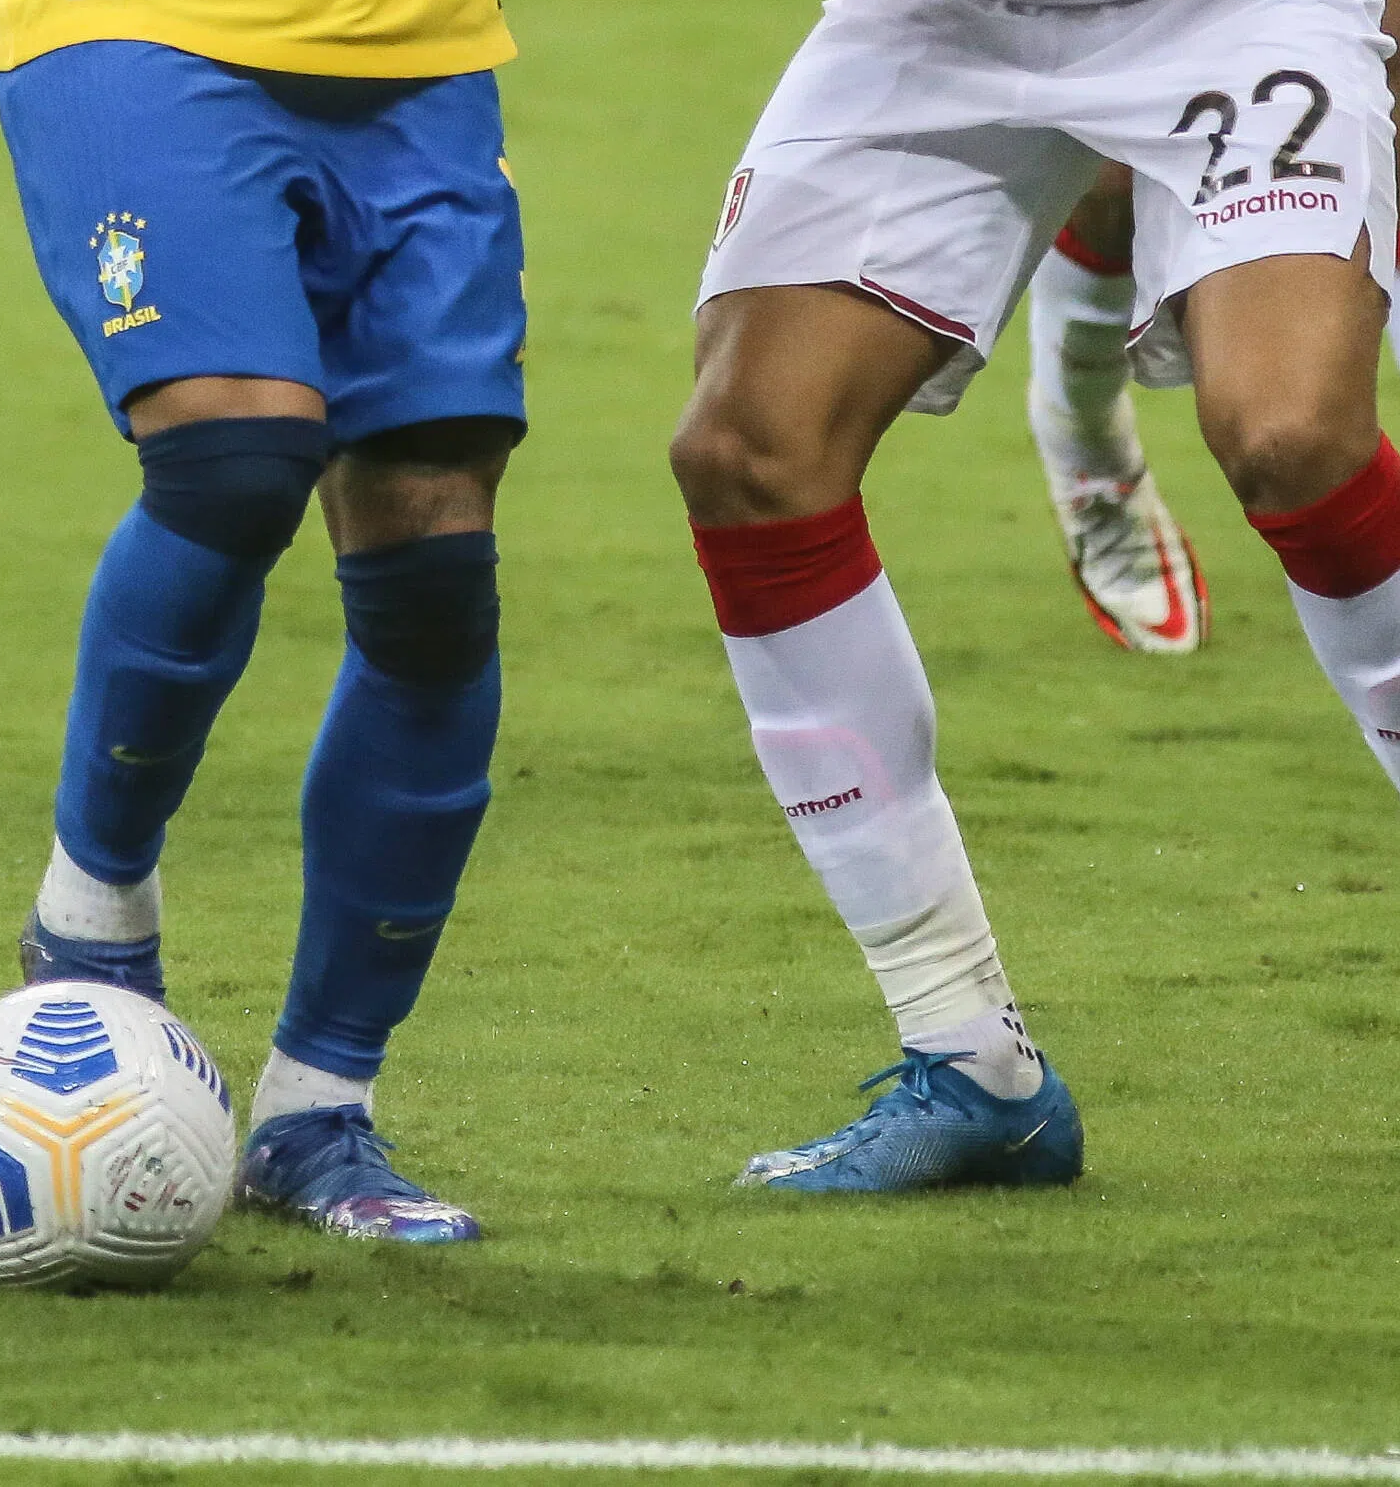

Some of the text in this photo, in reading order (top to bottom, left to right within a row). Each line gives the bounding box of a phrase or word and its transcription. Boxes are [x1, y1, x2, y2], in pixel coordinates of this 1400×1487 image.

[1168, 69, 1346, 207] 22
[1196, 189, 1338, 229] marathon
[103, 306, 162, 338] BRASIL
